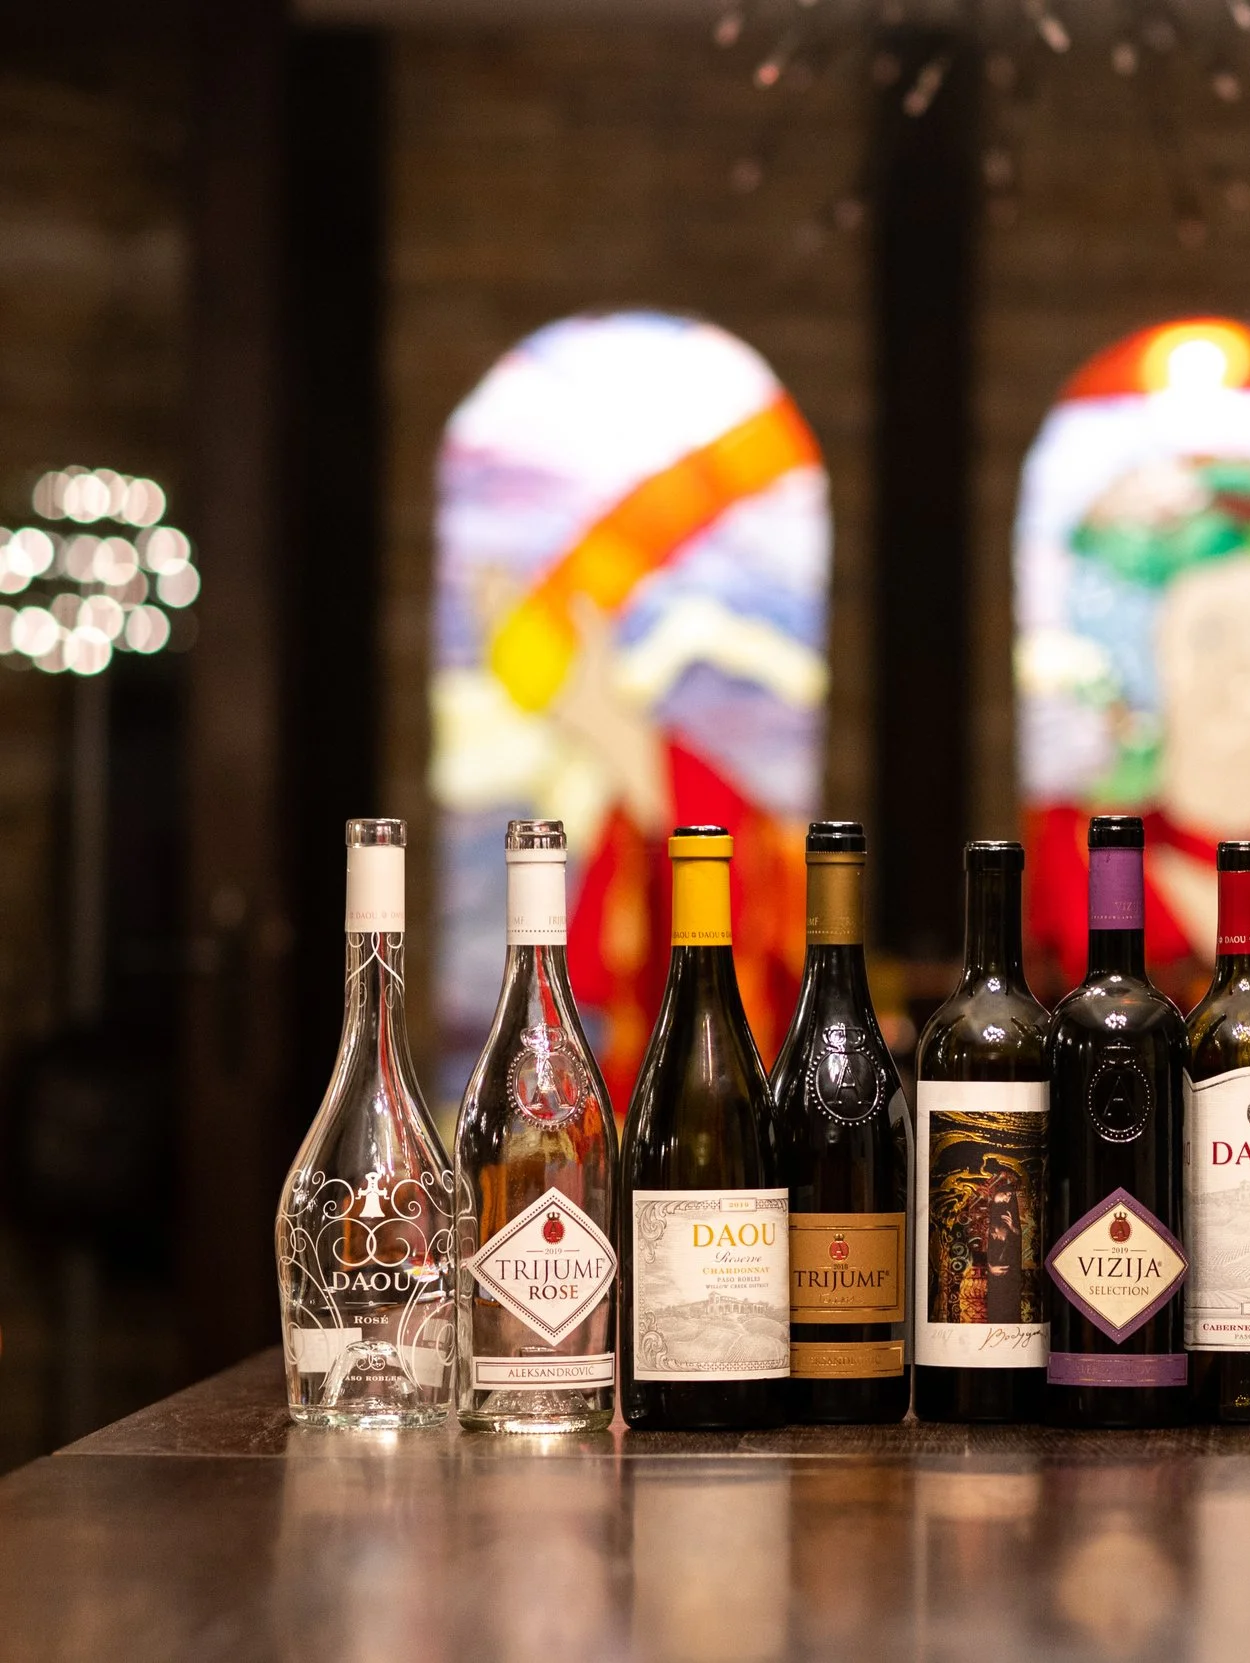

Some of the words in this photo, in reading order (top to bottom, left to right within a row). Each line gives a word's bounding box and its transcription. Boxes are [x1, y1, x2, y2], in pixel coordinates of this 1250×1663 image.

[698, 931, 720, 939] DAOU
[1225, 935, 1246, 944] DAOU
[692, 1222, 776, 1248] DAOU
[714, 1250, 763, 1263] Reserve
[1111, 1246, 1129, 1254] 2019
[495, 1257, 604, 1286] TRIJUMF
[702, 1266, 770, 1275] CHARDONNAY
[1077, 1256, 1162, 1284] VIZIJA
[332, 1271, 412, 1291] DAOU
[793, 1270, 887, 1292] TRIJUMF
[529, 1284, 579, 1300] ROSE
[1088, 1285, 1150, 1296] SELECTION
[342, 1374, 363, 1382] ASO
[507, 1365, 595, 1378] ALEKSANDROVIĆ
